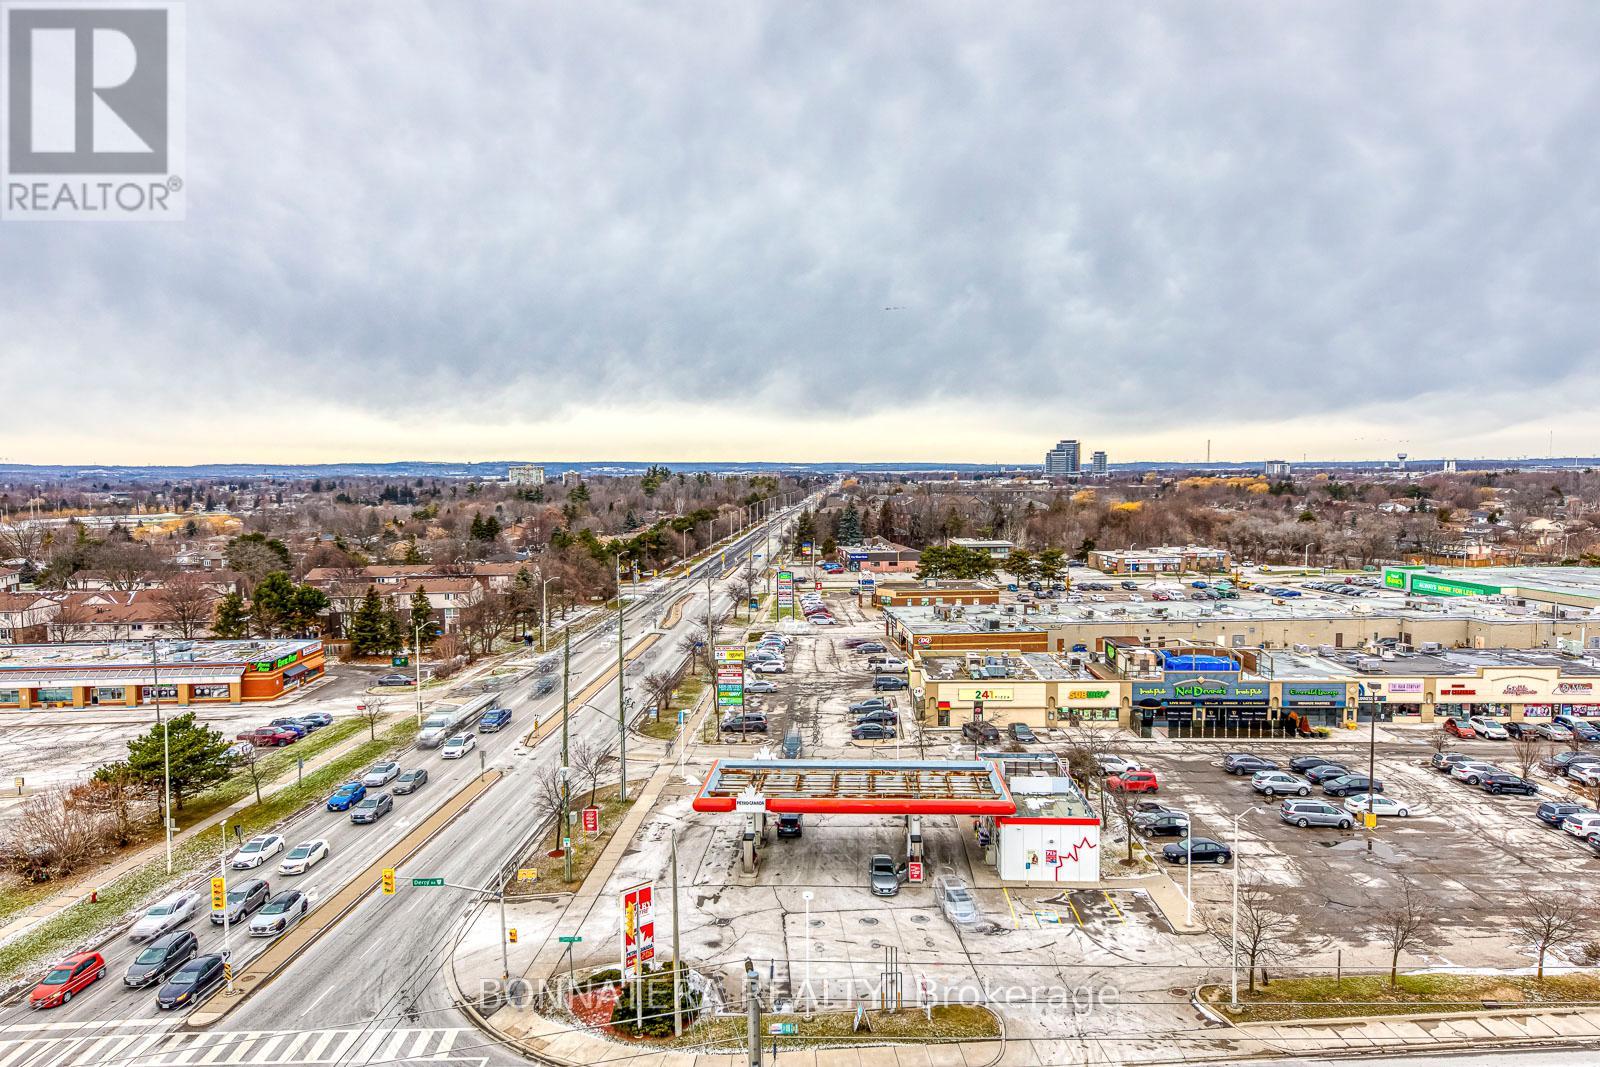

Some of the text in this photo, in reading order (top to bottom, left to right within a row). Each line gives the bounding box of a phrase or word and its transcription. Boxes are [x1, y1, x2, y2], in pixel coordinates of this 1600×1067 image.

[975, 690, 994, 699] 241
[1069, 690, 1110, 699] SUBWAY
[1175, 687, 1193, 698] Ned
